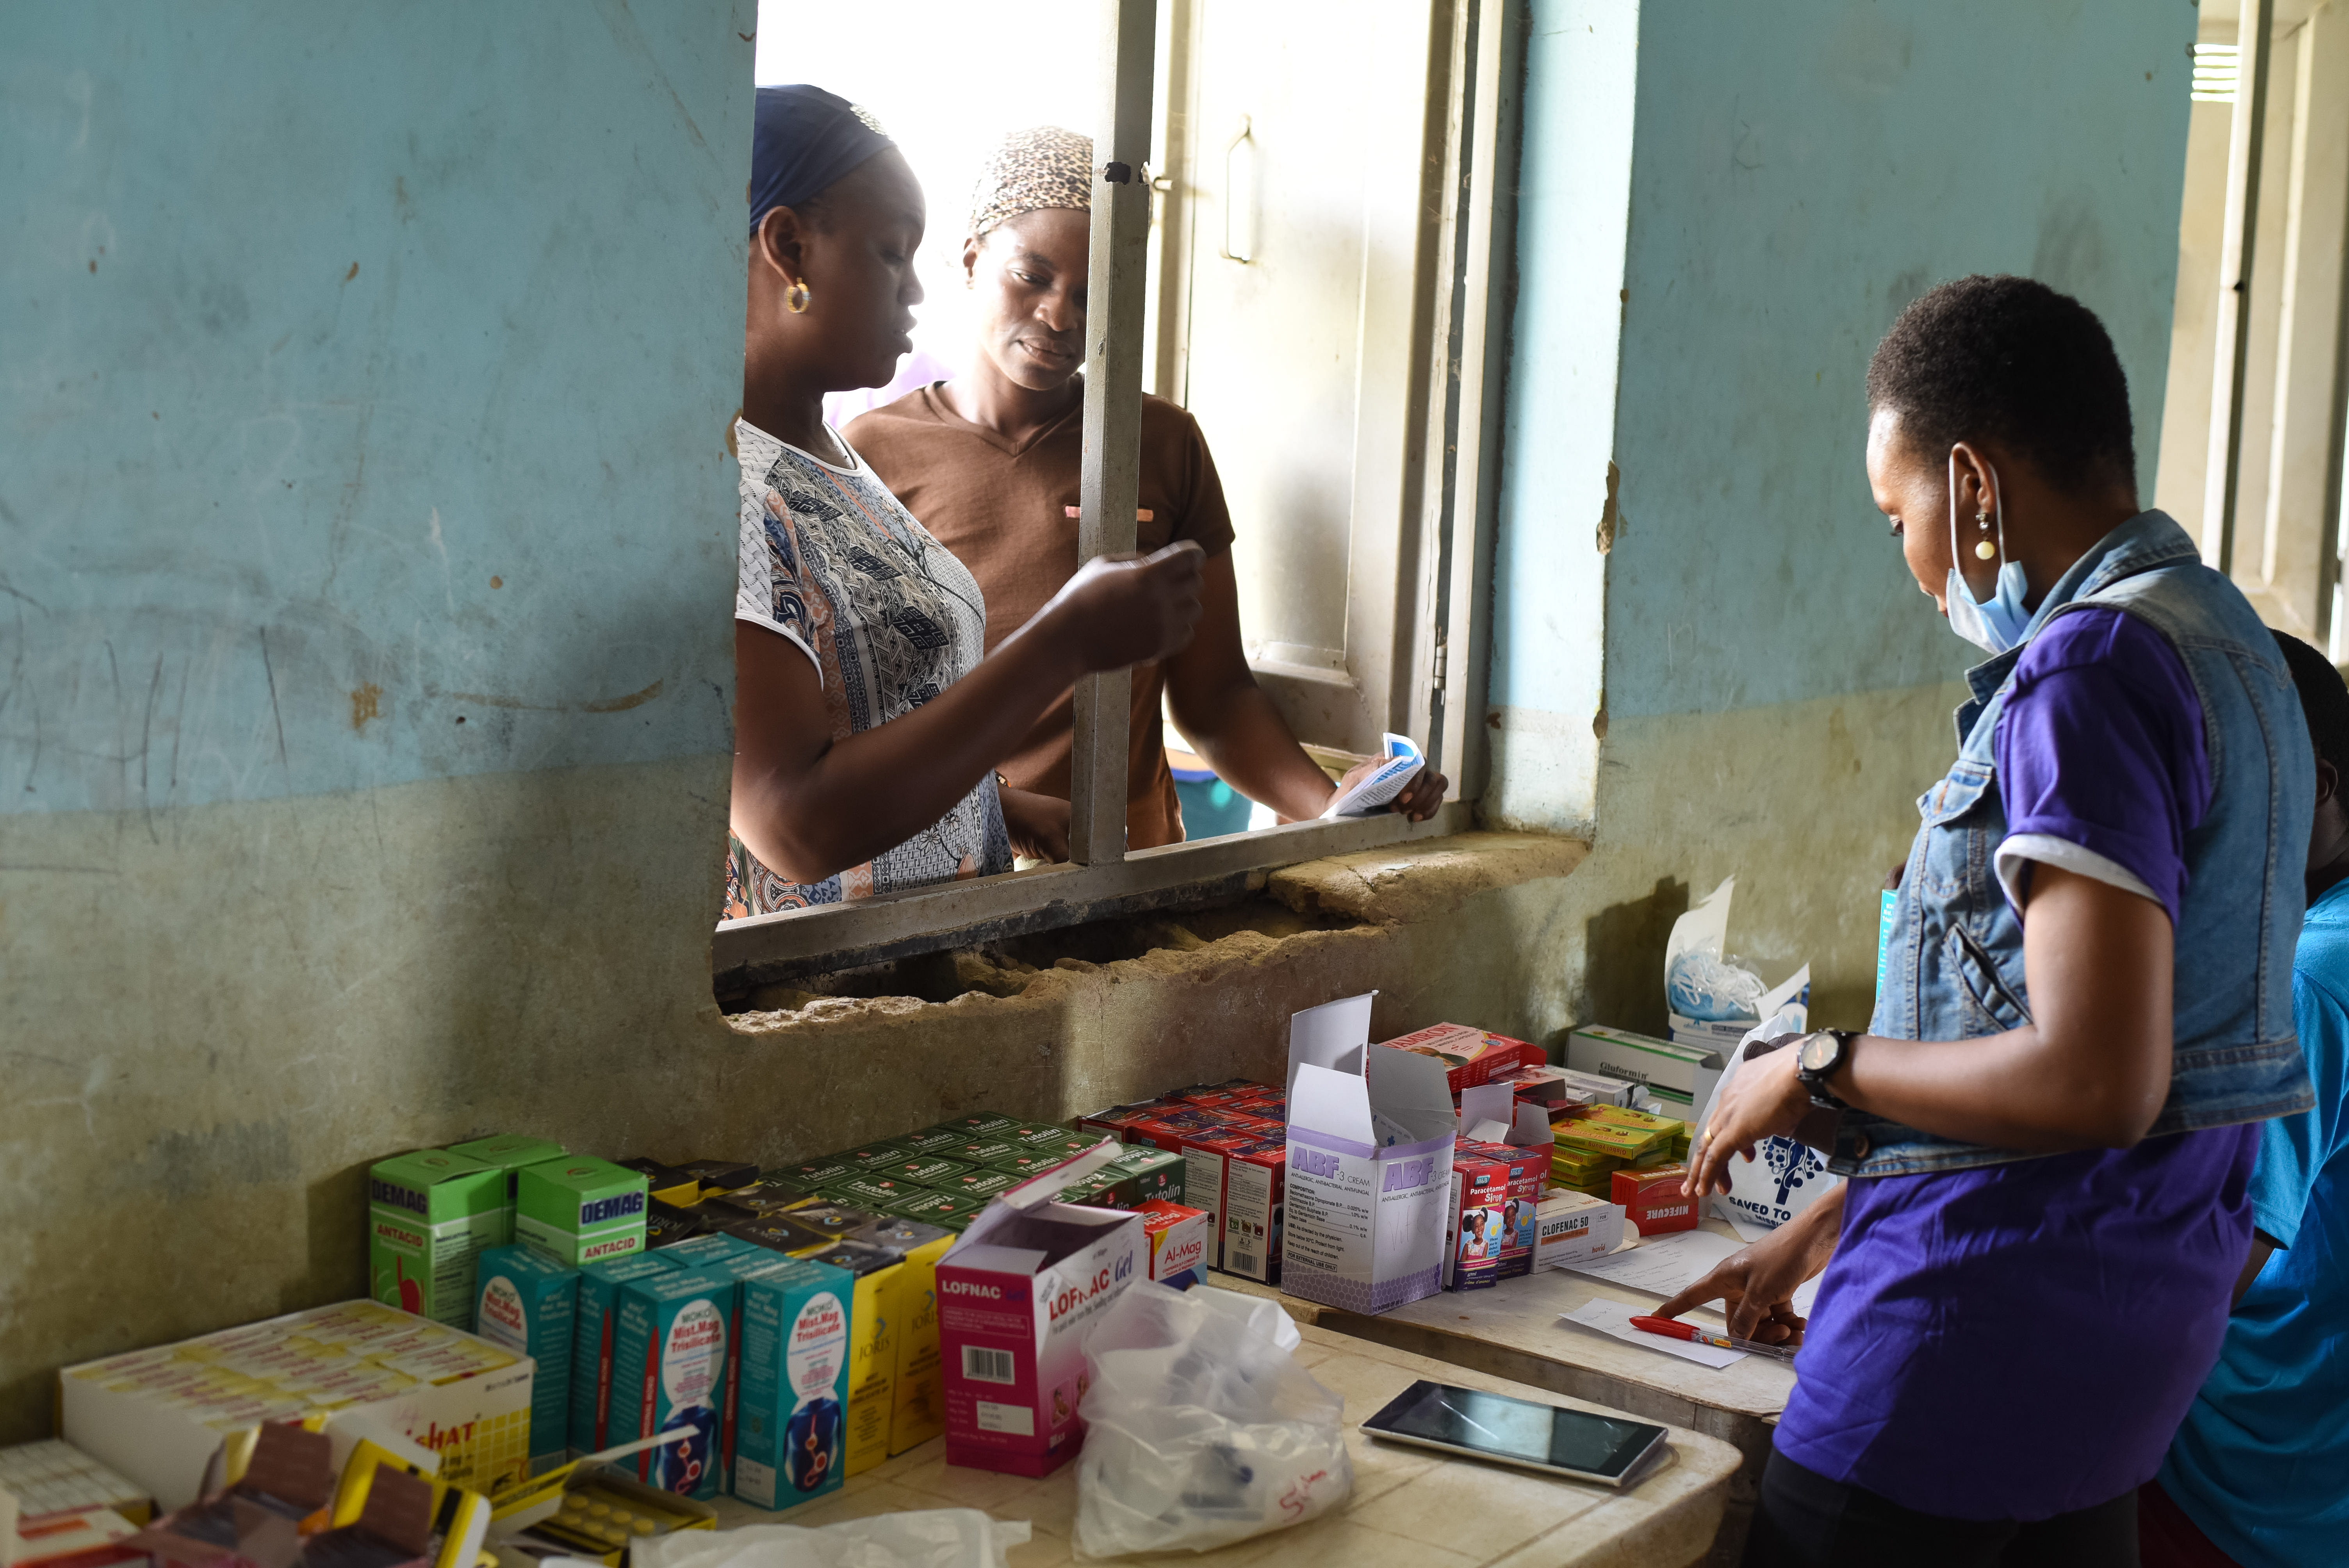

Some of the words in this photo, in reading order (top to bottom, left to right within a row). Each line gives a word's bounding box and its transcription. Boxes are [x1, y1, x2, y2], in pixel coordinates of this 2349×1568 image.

[966, 1118, 1008, 1132] Tutolin
[908, 1133, 953, 1147] Tutolin
[1017, 1128, 1060, 1142] Tutolin
[966, 1144, 1007, 1156] Tutolin
[1588, 1140, 1606, 1150] young
[855, 1149, 900, 1164] Tutolin
[1017, 1156, 1060, 1172] Tutolin
[798, 1165, 845, 1180] Tutolin
[905, 1162, 949, 1178] Tutolin
[961, 1175, 1007, 1191] Tutolin
[1347, 1176, 1370, 1187] CREAM
[1507, 1174, 1538, 1186] aracetamol
[851, 1180, 899, 1196] Tutolin
[1290, 1183, 1315, 1195] COMPOSITION:
[1344, 1186, 1370, 1196] ANTI-FUNGAL
[1470, 1183, 1506, 1195] Paracétamol
[1517, 1184, 1535, 1193] Syrup
[372, 1180, 427, 1215] DEMAG
[1485, 1193, 1502, 1203] Sirop
[582, 1191, 643, 1224] DEMAG
[1646, 1205, 1689, 1220] NIFECURE
[1729, 1196, 1769, 1215] SAVED
[1773, 1208, 1791, 1221] TO
[1542, 1218, 1578, 1236] CLOFENAC
[1580, 1216, 1589, 1227] 50
[377, 1224, 423, 1247] ANTACID
[1325, 1234, 1342, 1242] physician.
[585, 1237, 636, 1259] ANTACID
[1164, 1241, 1201, 1264] Al-Mag
[1592, 1244, 1606, 1253] hovid
[1115, 1249, 1133, 1282] Gel
[1296, 1254, 1315, 1265] EXTERNAL
[942, 1279, 1002, 1300] LOFNAC
